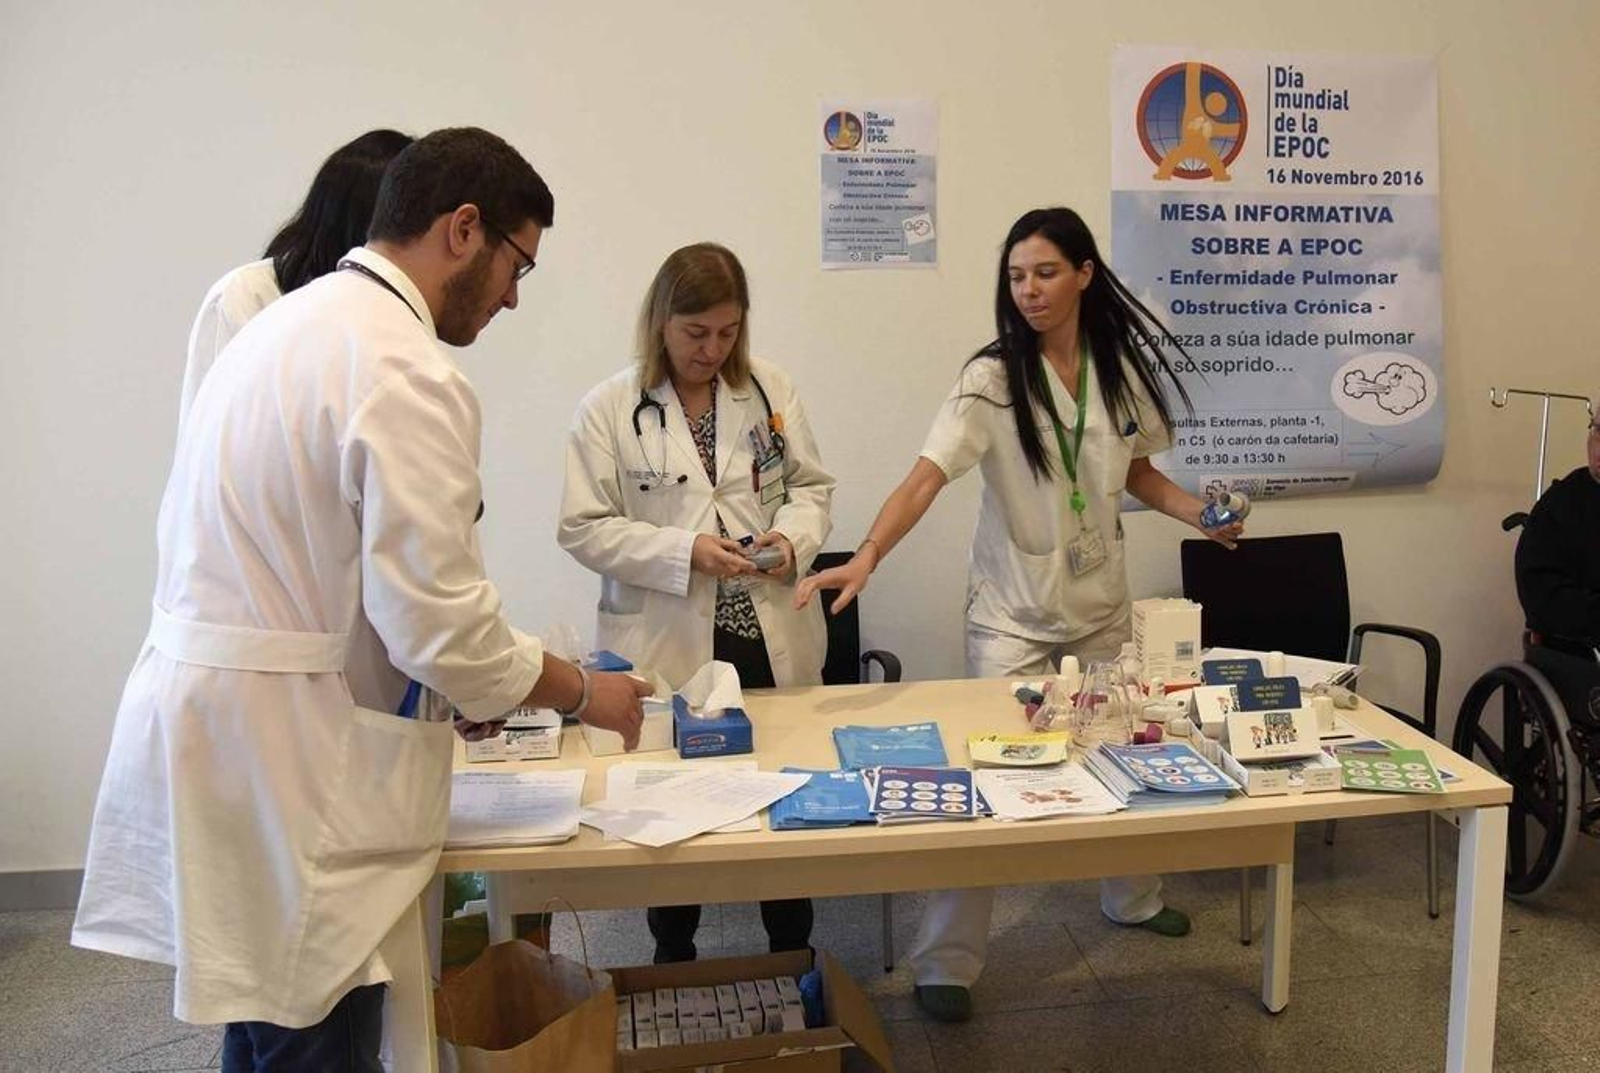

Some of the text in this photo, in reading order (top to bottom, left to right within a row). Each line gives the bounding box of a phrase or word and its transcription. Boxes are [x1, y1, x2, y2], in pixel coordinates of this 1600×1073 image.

[1274, 65, 1304, 88] Día
[1274, 89, 1350, 111] mundial
[1274, 112, 1318, 133] de la
[1274, 136, 1331, 159] EPOC
[1266, 168, 1424, 185] 16 Novembro 2016
[1160, 204, 1394, 223] MESA INFORMATIVA
[1191, 237, 1363, 256] SOBRE A EPOC
[1169, 269, 1296, 286] Enfermidade
[1302, 270, 1398, 286] Pulmonar
[1170, 299, 1288, 315] Obstructiva
[1294, 298, 1372, 315] Crónica
[1210, 334, 1222, 347] a
[1227, 329, 1260, 347] súa
[1265, 329, 1319, 347] idade
[1323, 330, 1415, 351] pulmonar
[1210, 416, 1267, 429] Externas,
[1269, 416, 1307, 429] planta
[1189, 434, 1206, 446] C5
[1227, 432, 1262, 446] carón
[1265, 434, 1280, 445] da
[1185, 452, 1286, 465] de 9:30 a 13:30 h
